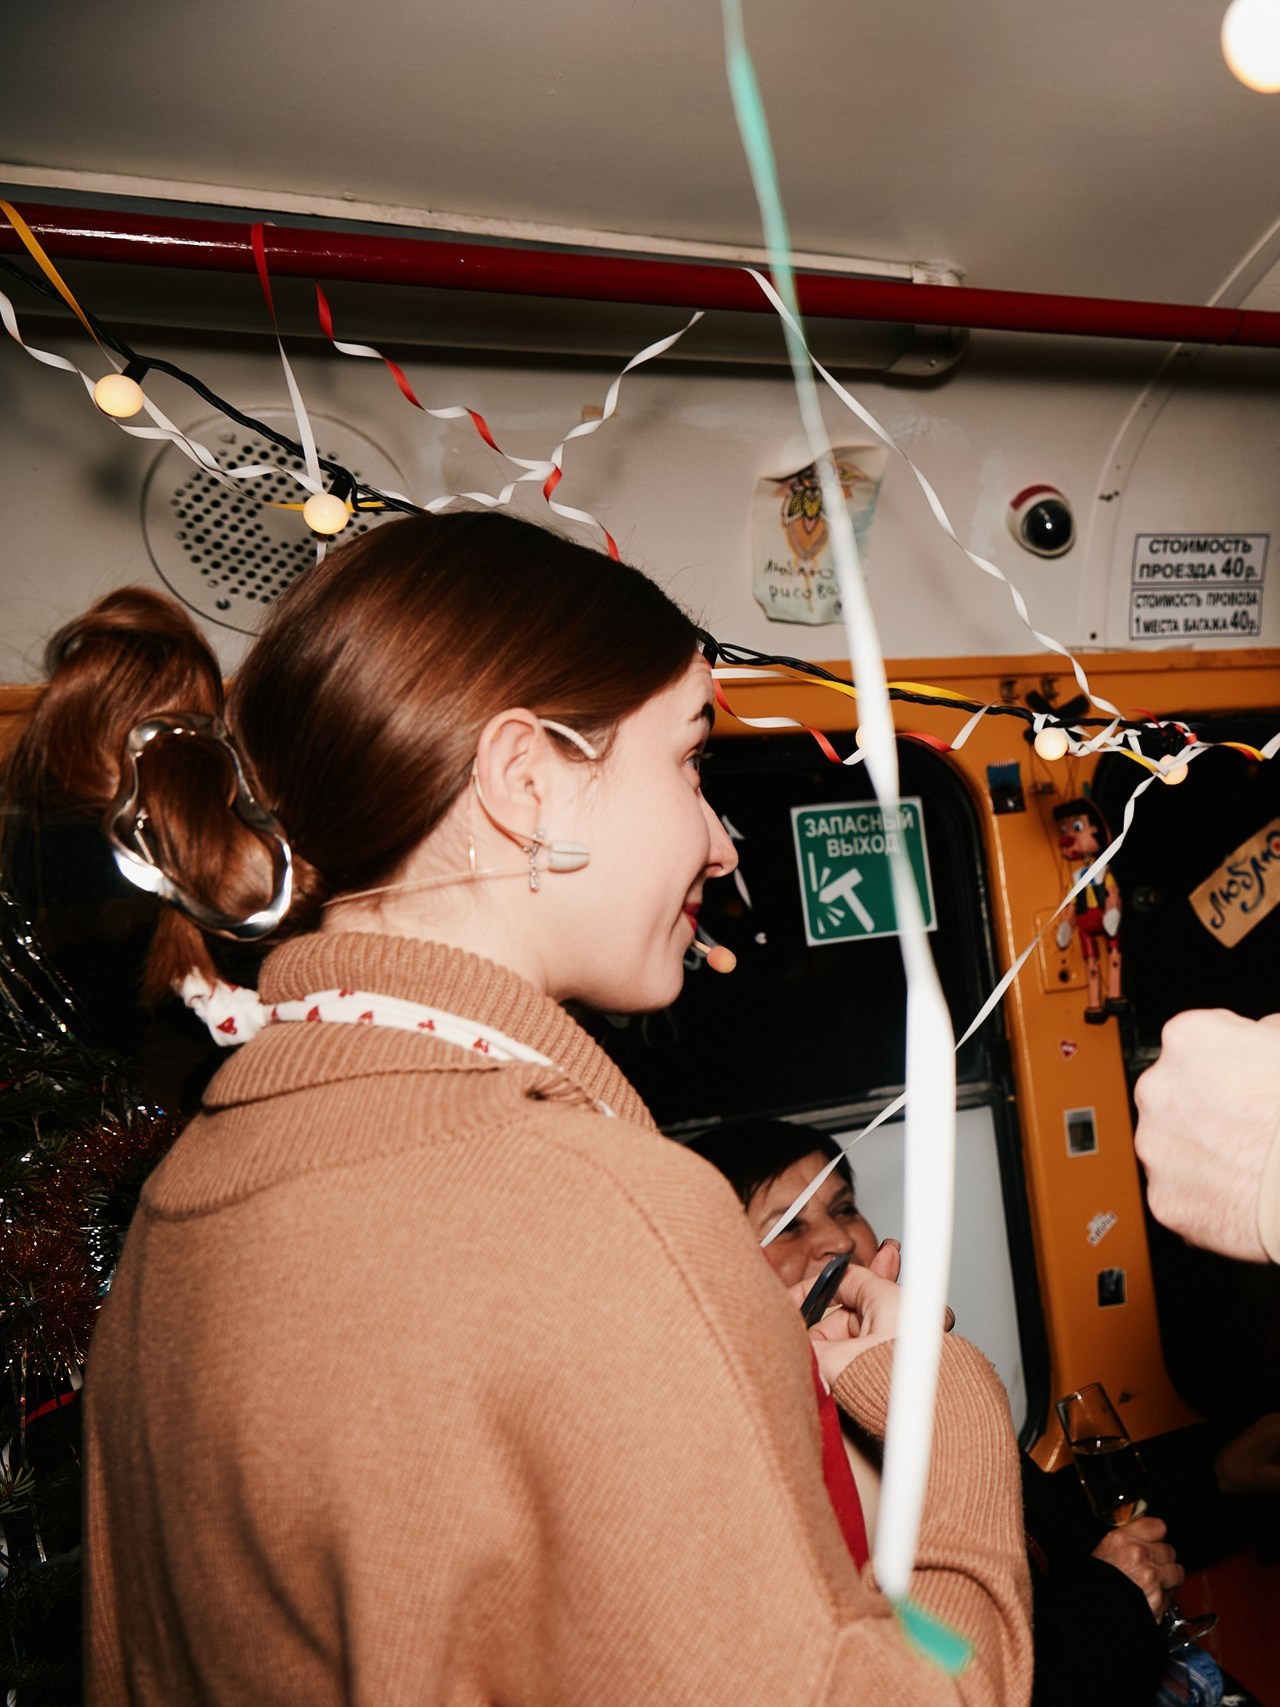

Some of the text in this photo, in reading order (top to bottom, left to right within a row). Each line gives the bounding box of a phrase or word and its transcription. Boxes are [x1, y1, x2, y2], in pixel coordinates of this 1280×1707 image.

[1148, 539, 1252, 554] СТОИМОСТЬ
[1140, 563, 1216, 581] ПРОЕЗДА
[1136, 592, 1257, 608] СТОИМОСТЬ ПРОВОЗА
[1135, 617, 1141, 633] 1
[1143, 618, 1179, 633] МЕСТА
[1184, 617, 1228, 632] БАГАЖА
[804, 808, 914, 838] ЗАПАСНЫЙ
[826, 833, 900, 858] ВЫХОД
